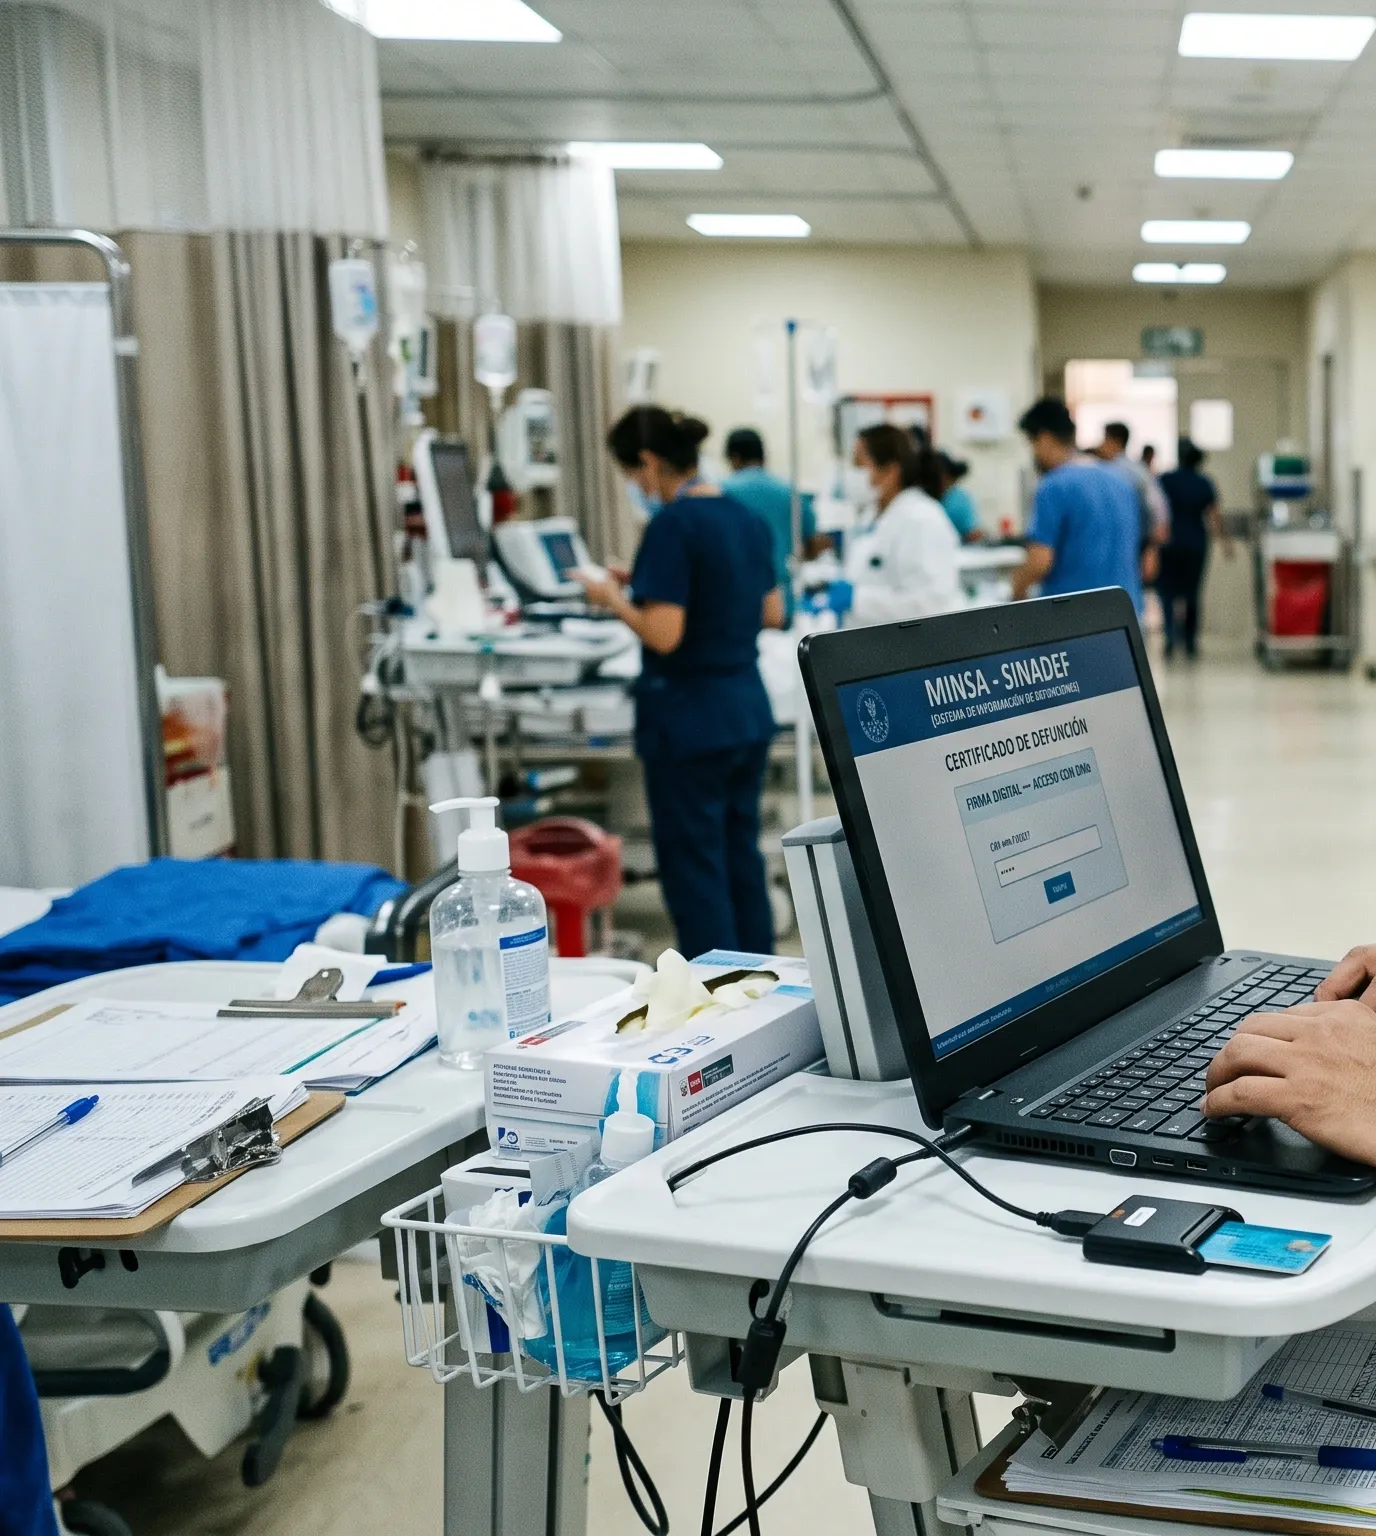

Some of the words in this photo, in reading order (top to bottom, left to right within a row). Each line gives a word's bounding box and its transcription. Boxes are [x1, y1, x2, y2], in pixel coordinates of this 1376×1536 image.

[924, 669, 991, 707] MINSA
[1001, 651, 1070, 690] SINADEF
[945, 738, 1015, 772] CERTIFICADO
[1016, 733, 1031, 752] DE
[1031, 716, 1089, 746] DEFUNCIÓN
[966, 793, 993, 811] FIRMA
[993, 783, 1022, 802] DIGITAL
[1032, 771, 1060, 790] ACCESO
[1060, 768, 1076, 781] CON
